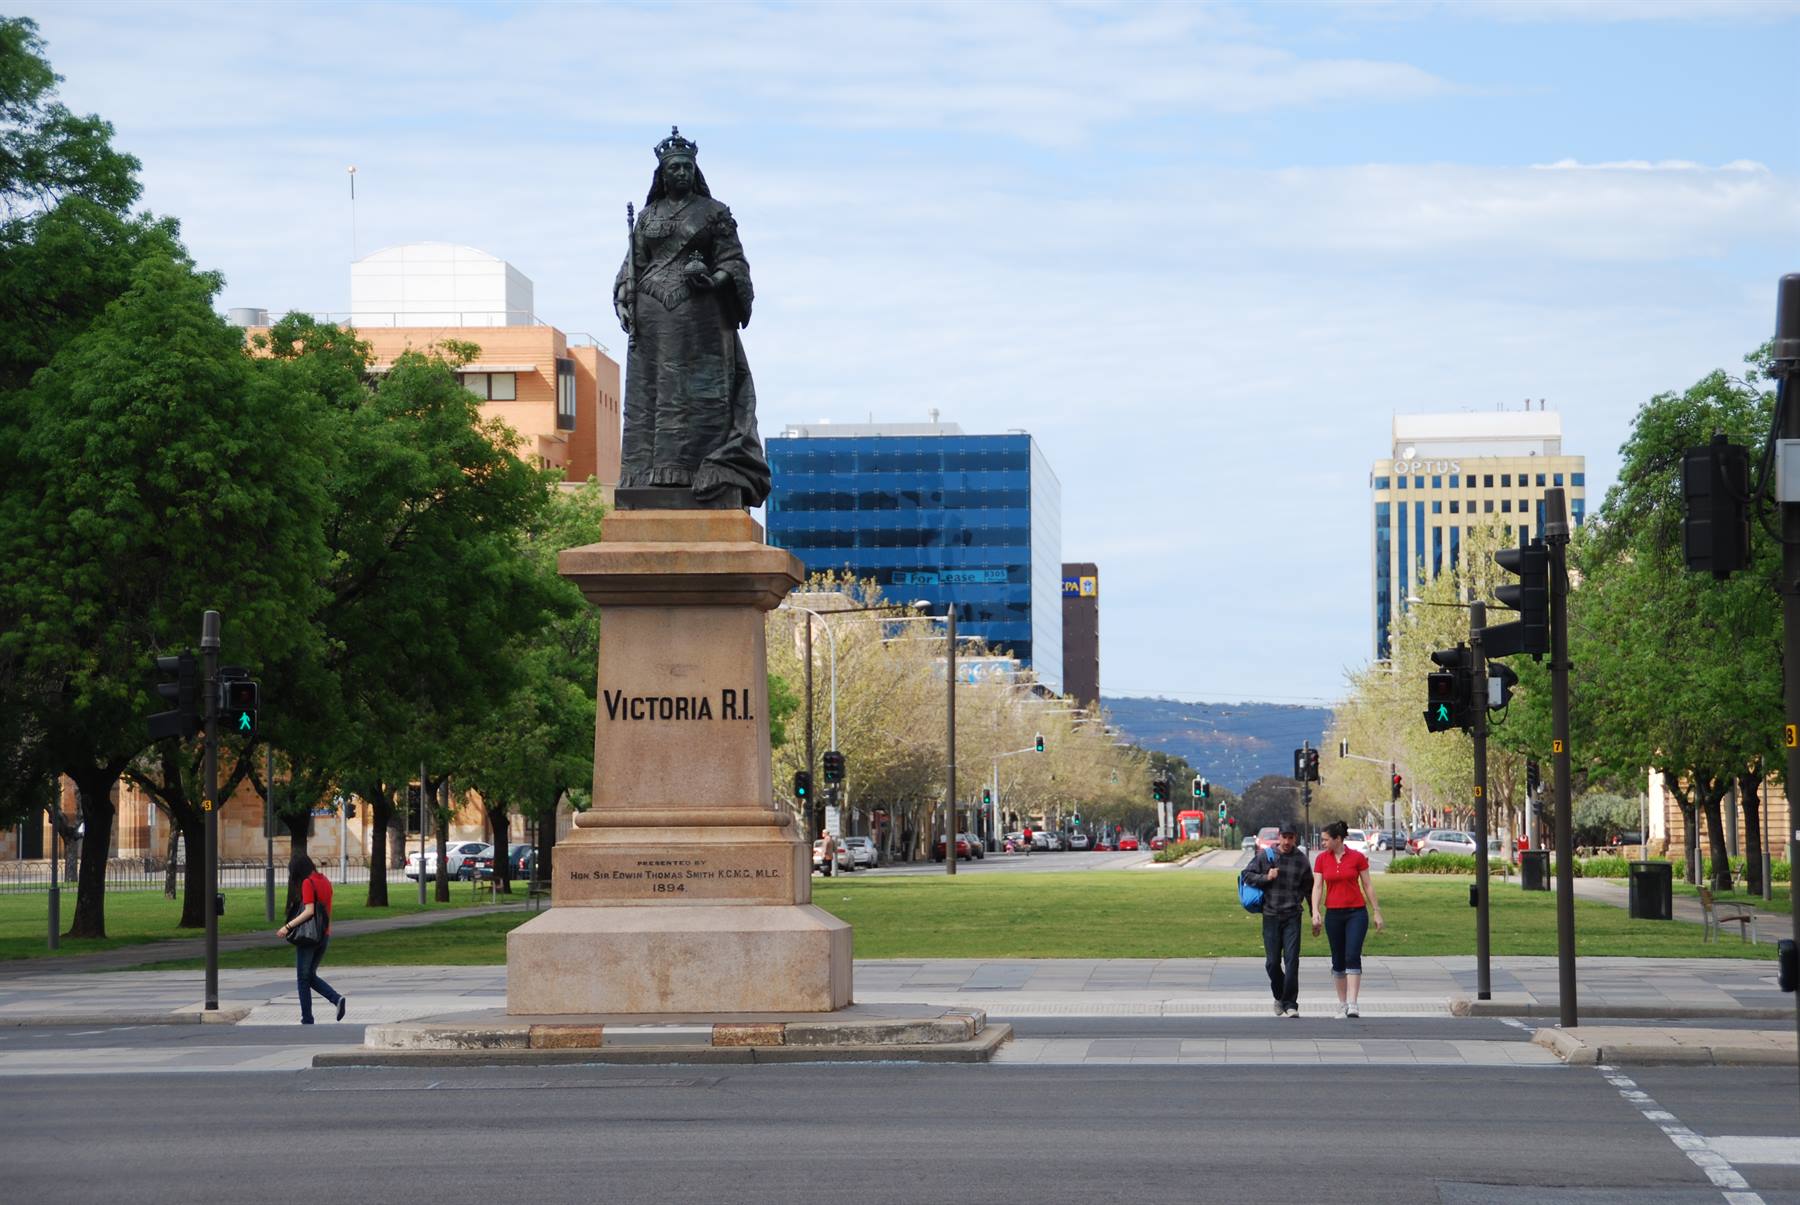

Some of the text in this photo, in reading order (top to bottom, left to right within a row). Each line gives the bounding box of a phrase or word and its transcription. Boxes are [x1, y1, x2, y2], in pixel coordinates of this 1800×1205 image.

[1394, 461, 1461, 474] OPTUS
[911, 569, 976, 584] For Lease
[603, 688, 754, 721] VICTORIA R.I.
[1554, 742, 1560, 751] 7
[645, 870, 684, 879] THOMAS
[686, 870, 715, 879] SMITH
